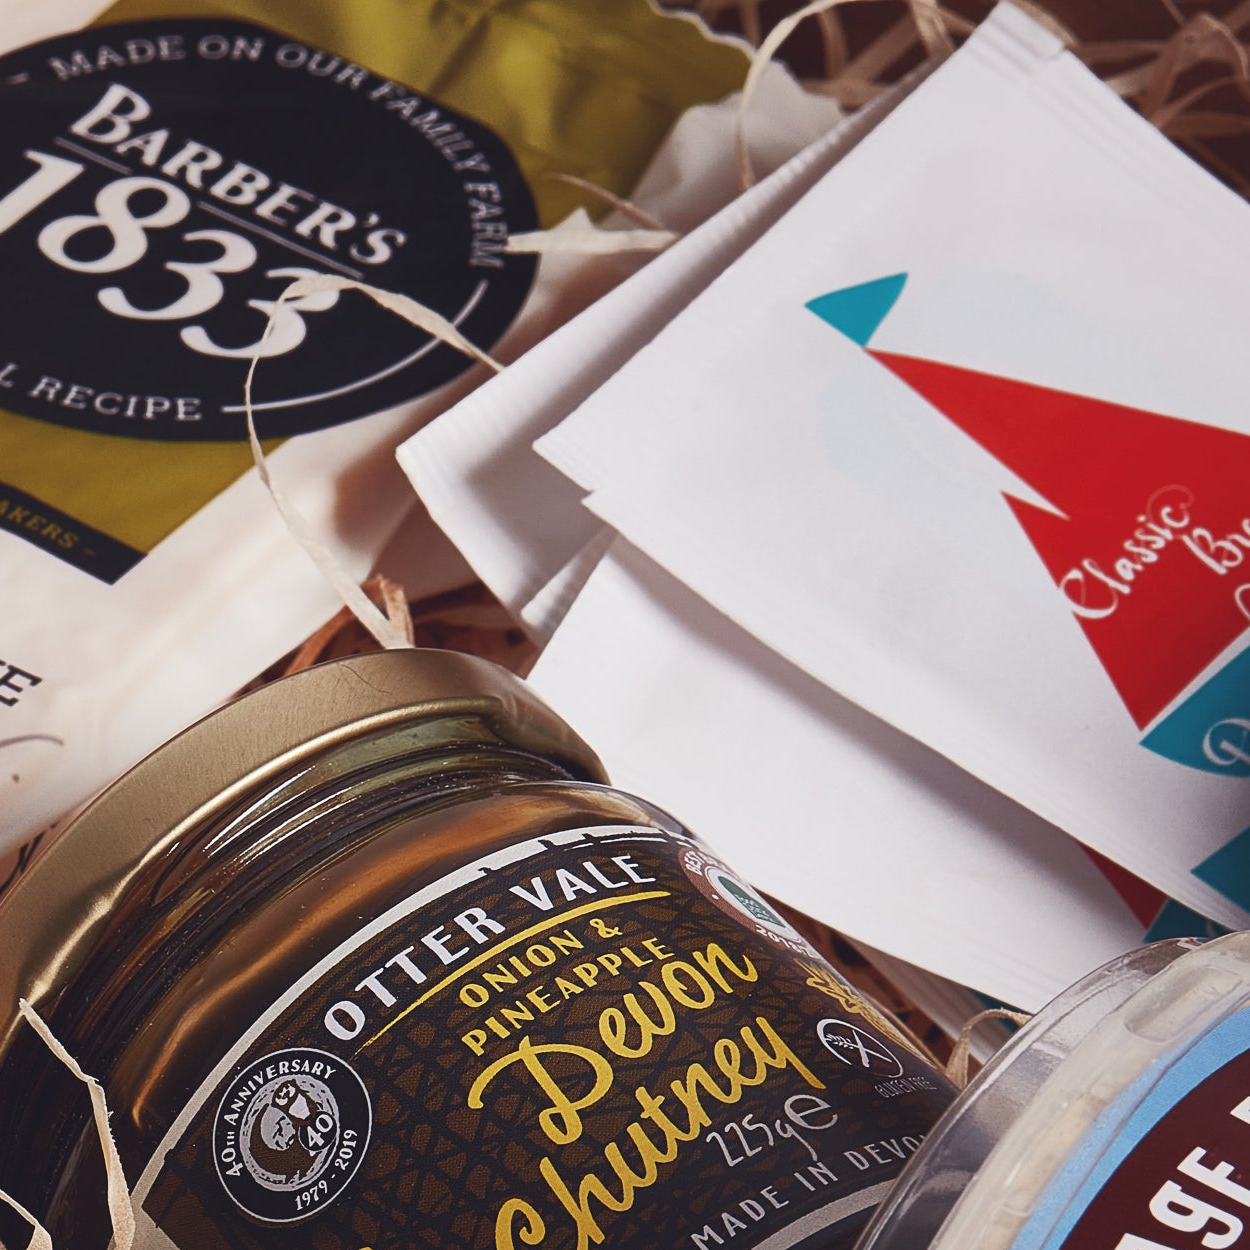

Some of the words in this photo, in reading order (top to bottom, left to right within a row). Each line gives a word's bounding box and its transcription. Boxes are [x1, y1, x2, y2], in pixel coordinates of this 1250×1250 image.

[49, 33, 184, 81] MADE
[197, 34, 264, 62] ON
[275, 39, 366, 90] OUR
[369, 78, 492, 174] FAMILY
[463, 178, 507, 269] FARM
[29, 377, 203, 422] RECIPE
[1059, 485, 1194, 619] Classic
[324, 904, 506, 1042] OTTER
[511, 853, 662, 911] VALE
[459, 935, 585, 1007] ONION
[594, 917, 623, 938] &
[467, 936, 676, 1056] PINEAPPLE
[467, 942, 759, 1145] Devon
[224, 1059, 337, 1126] ANNIVERSARY
[306, 1114, 333, 1147] 40
[221, 1131, 243, 1177] 40TH
[295, 1180, 328, 1210] 1979
[334, 1129, 358, 1171] 2019
[793, 1161, 839, 1192] IN
[844, 1134, 930, 1171] DEVO
